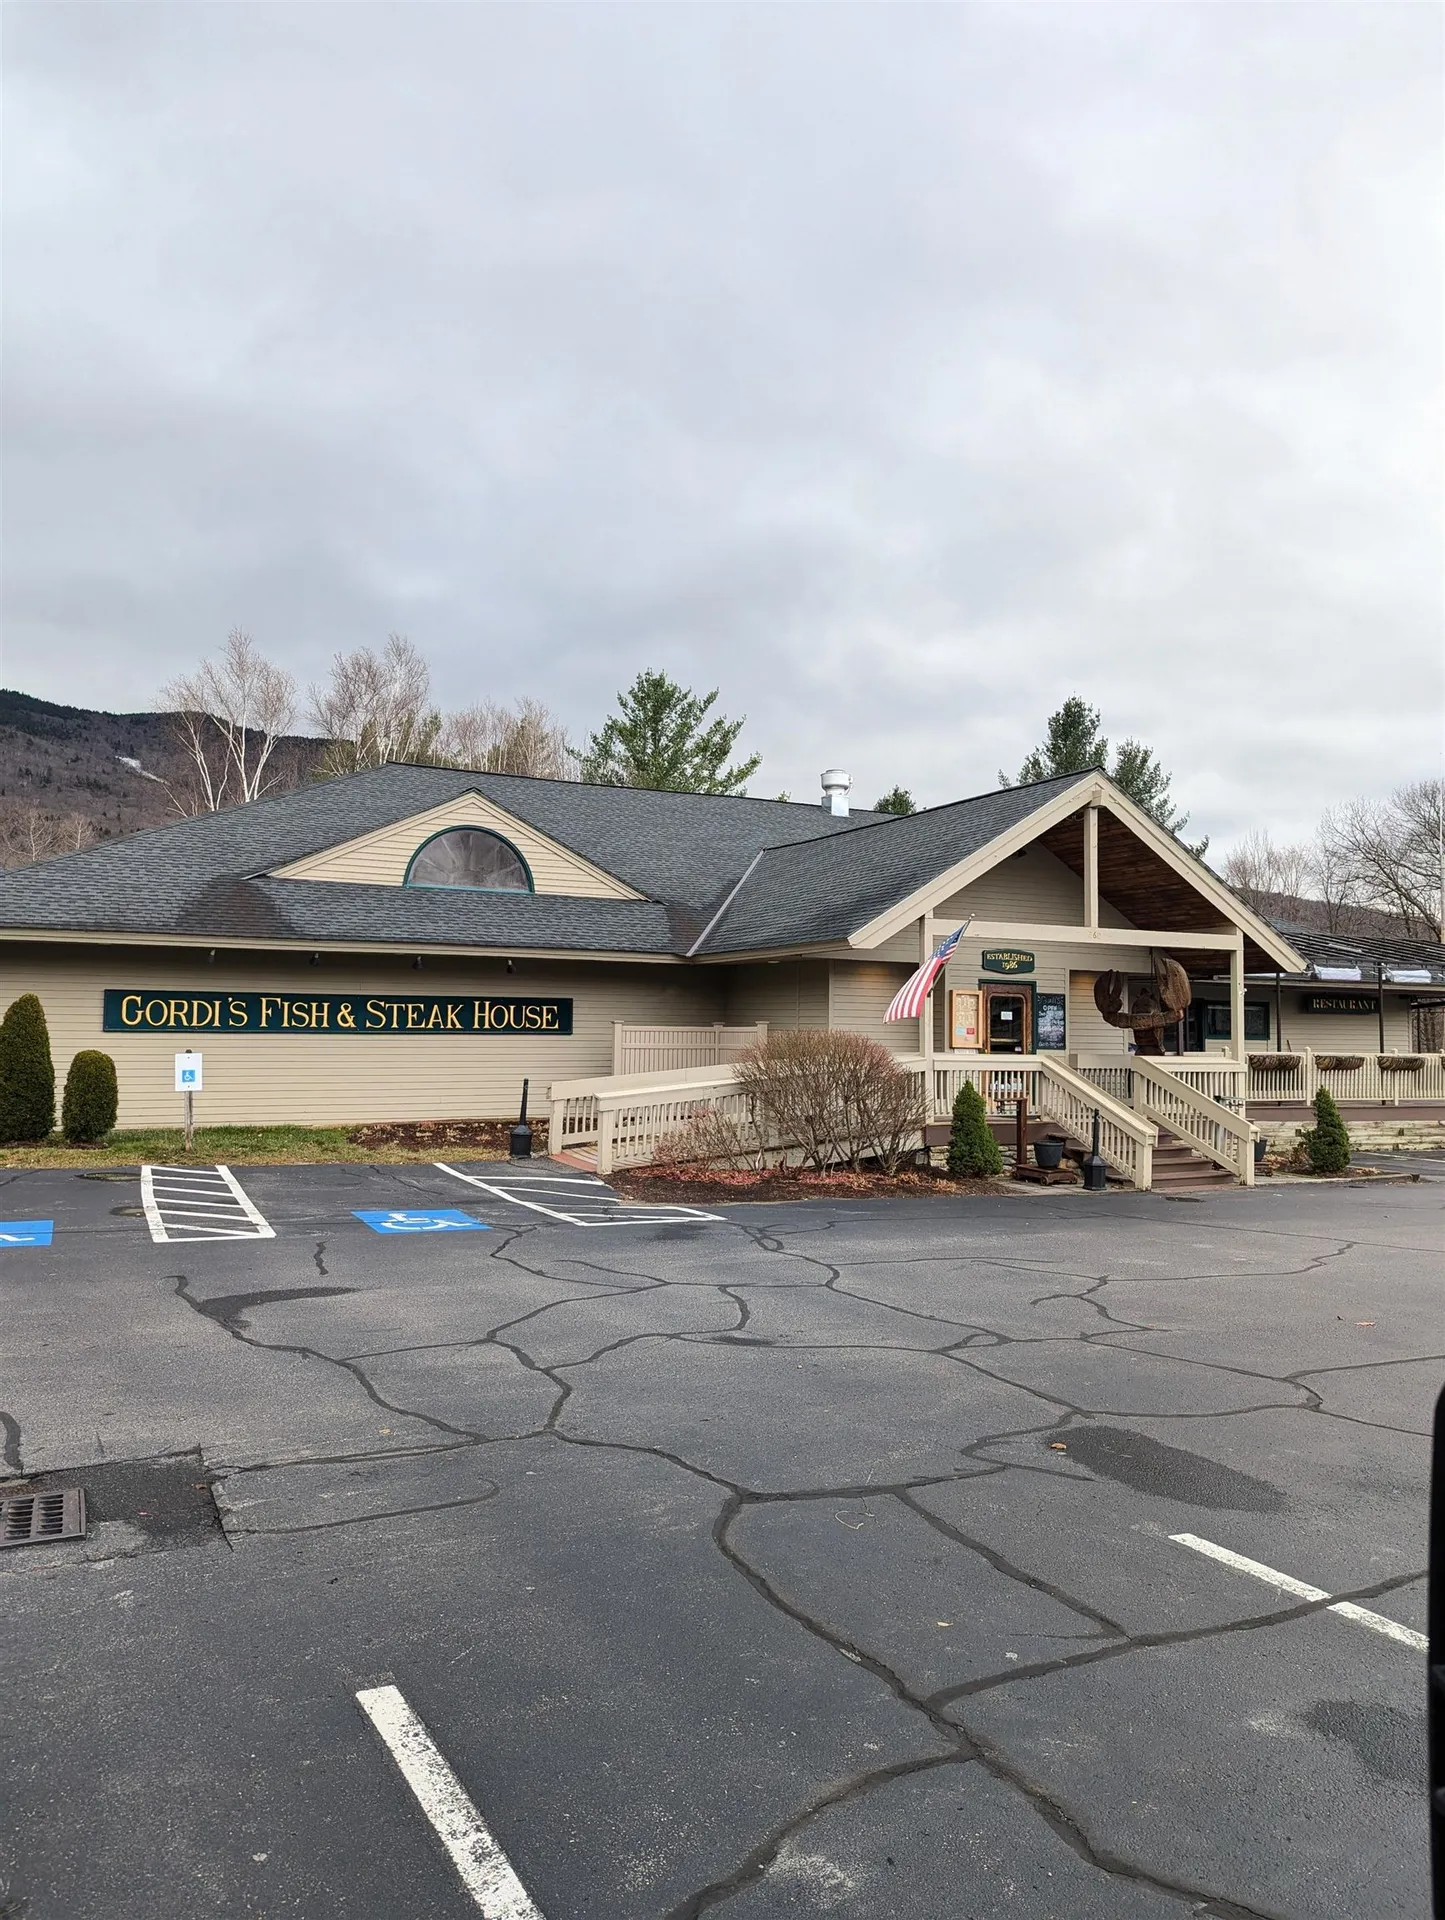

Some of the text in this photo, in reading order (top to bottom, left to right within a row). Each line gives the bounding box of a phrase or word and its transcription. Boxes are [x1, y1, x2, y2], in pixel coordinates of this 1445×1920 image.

[986, 952, 1033, 962] ESTABLISHED
[1002, 960, 1018, 970] 1986
[1313, 998, 1377, 1010] RESTAURANT
[121, 995, 559, 1029] GORDI'S FISH & STEAK HOUSE
